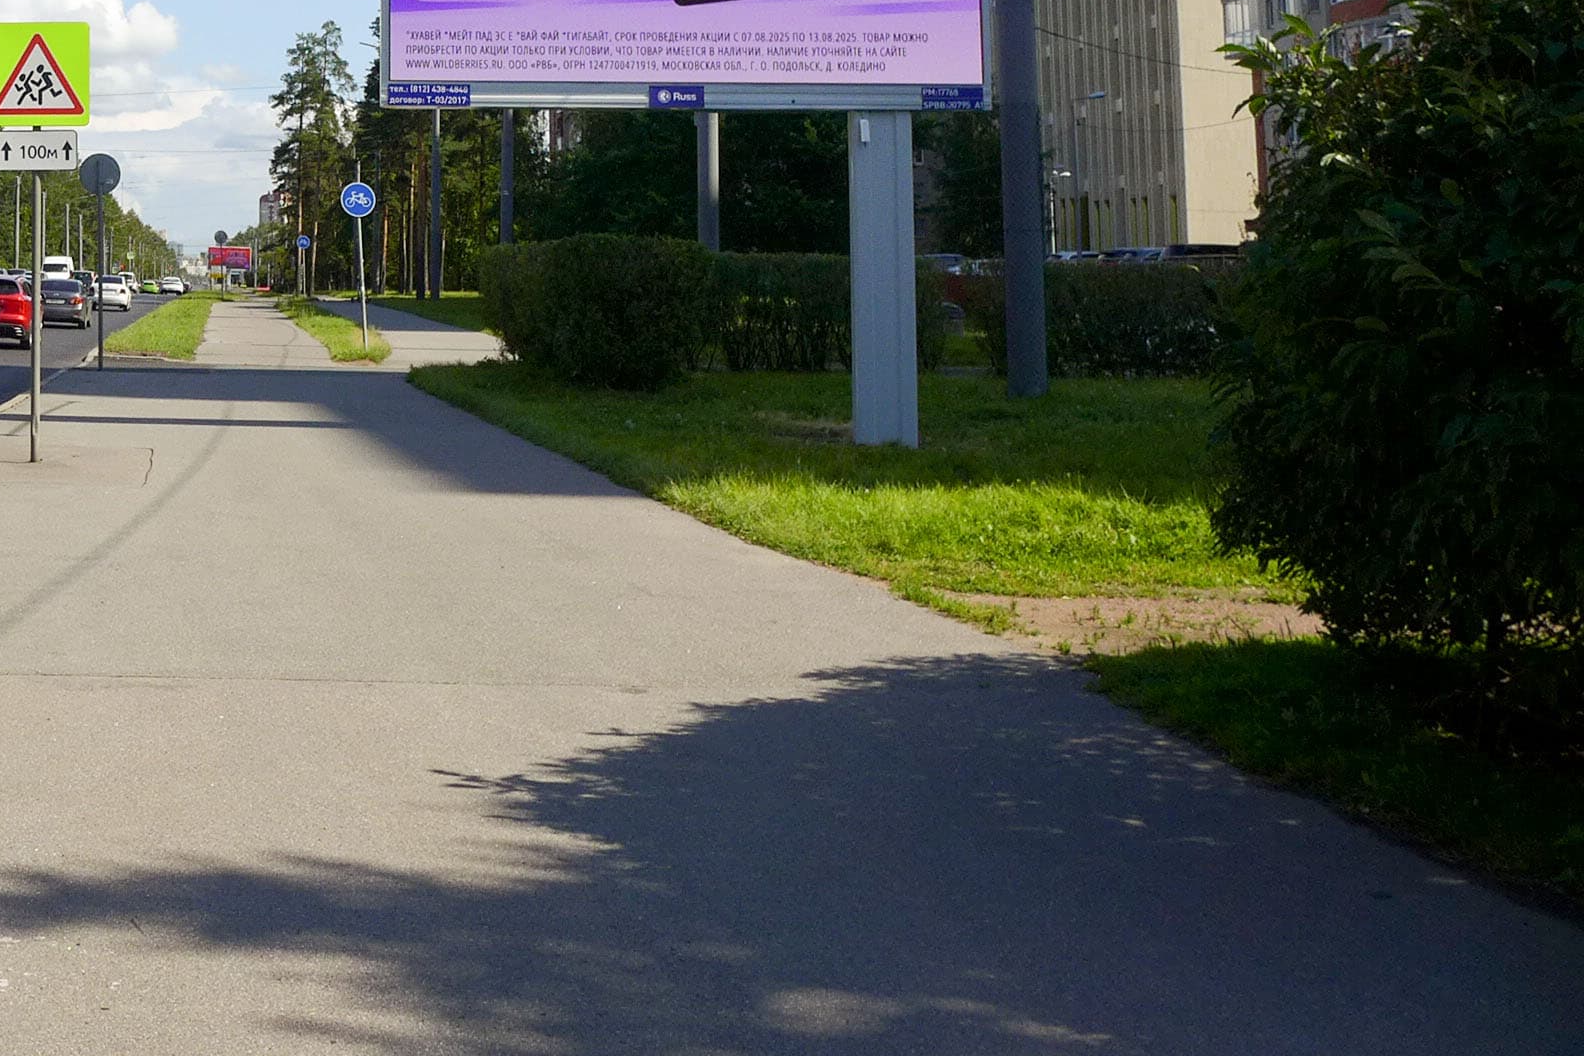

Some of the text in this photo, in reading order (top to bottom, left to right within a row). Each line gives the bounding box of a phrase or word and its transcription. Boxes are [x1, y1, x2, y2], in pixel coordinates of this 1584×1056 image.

[475, 31, 493, 42] ПАД
[495, 31, 506, 41] ЭС
[540, 30, 560, 41] ФАЙ
[615, 32, 638, 41] СРОК
[640, 32, 698, 43] ПРОВЕДЕНИЯ
[700, 32, 730, 43] АКЦИИ
[741, 32, 790, 42] 07.08.2025
[792, 32, 806, 42] ПО
[862, 33, 890, 42] ТОВАР
[893, 33, 928, 42] МОЖНО
[406, 45, 462, 55] ПРИОБРЕСТИ
[465, 46, 478, 55] ПО
[480, 46, 509, 56] АКЦИИ
[512, 46, 545, 55] ТОЛЬКО
[548, 46, 566, 55] ПРИ
[569, 46, 612, 57] УСЛОВИИ,
[616, 46, 633, 56] ЧТО
[635, 46, 663, 56] ТОВАР
[666, 46, 706, 56] ИМЕЕТСЯ
[709, 46, 715, 56] В
[767, 47, 808, 56] НАЛИЧИЕ
[811, 45, 862, 56] УТОЧНЯЙТЕ
[866, 47, 877, 56] НА
[880, 45, 907, 56] САЙТЕ
[508, 60, 528, 69] ООО
[563, 60, 585, 70] ОГРН
[662, 61, 720, 70] МОСКОВСКАЯ
[837, 61, 886, 72] КОЛЕДИНО
[410, 85, 430, 94] (812)
[672, 92, 697, 101] Russ
